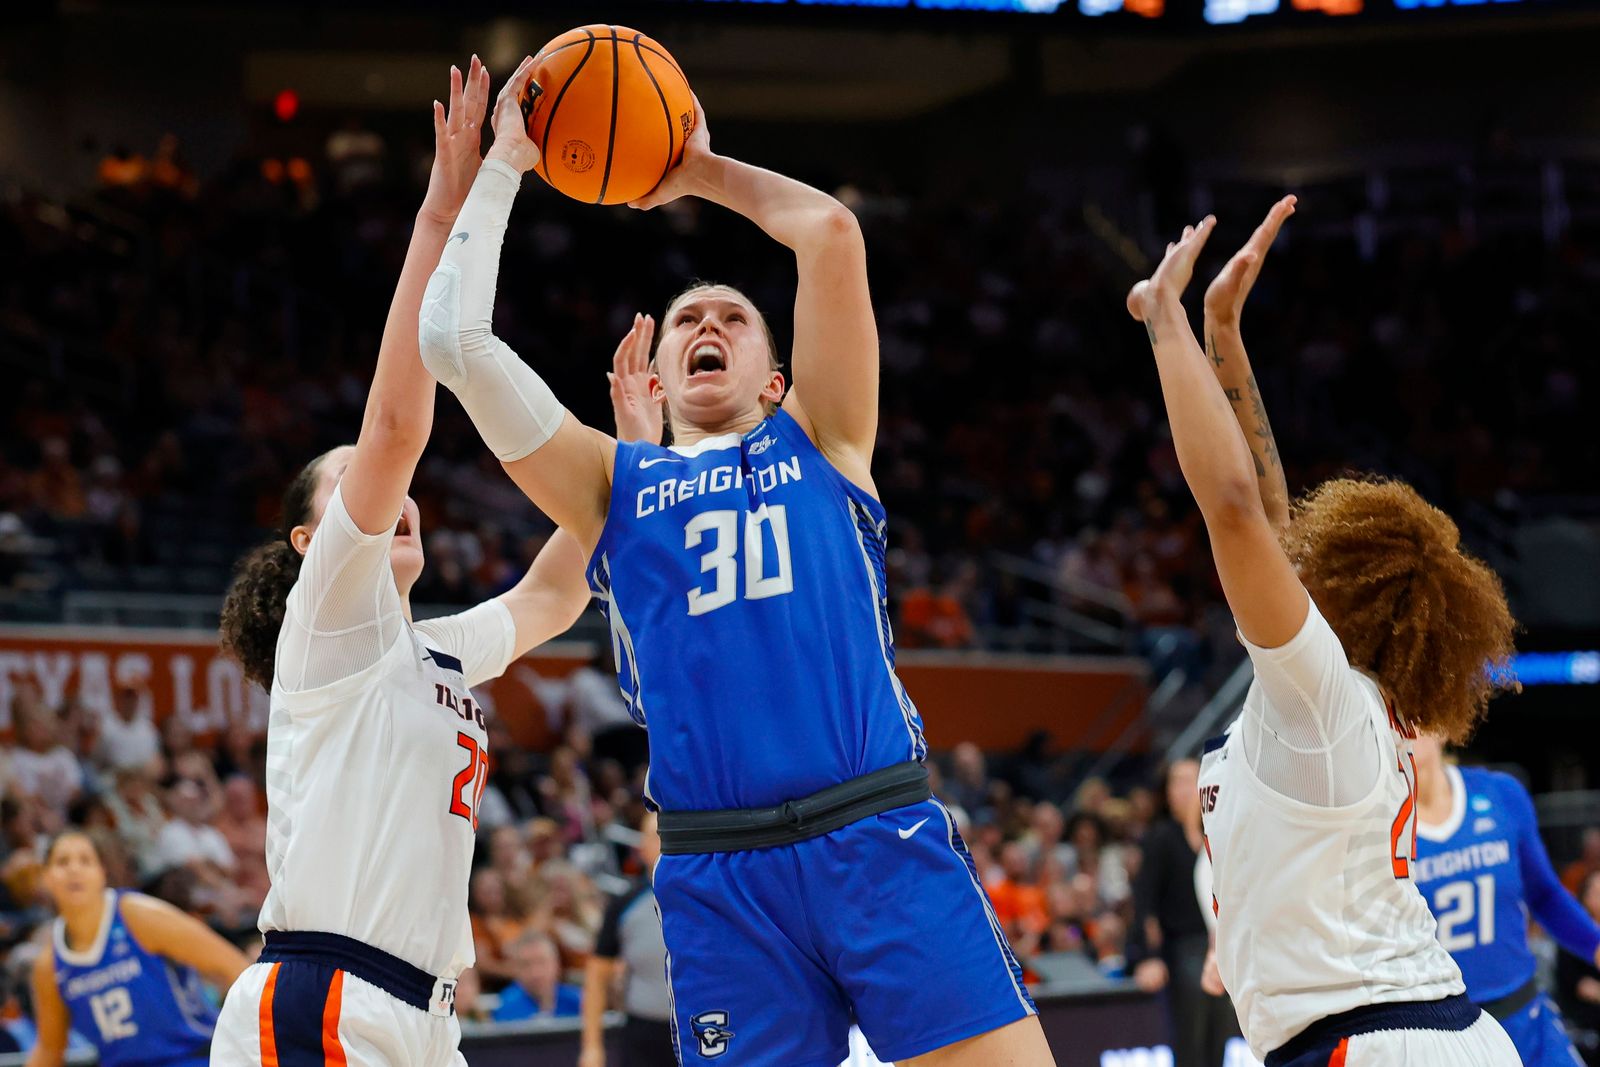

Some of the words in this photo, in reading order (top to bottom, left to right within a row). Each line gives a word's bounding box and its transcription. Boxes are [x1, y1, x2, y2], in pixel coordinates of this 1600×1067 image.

[684, 505, 793, 616] 30
[1434, 874, 1495, 951] 21
[90, 986, 139, 1043] 12
